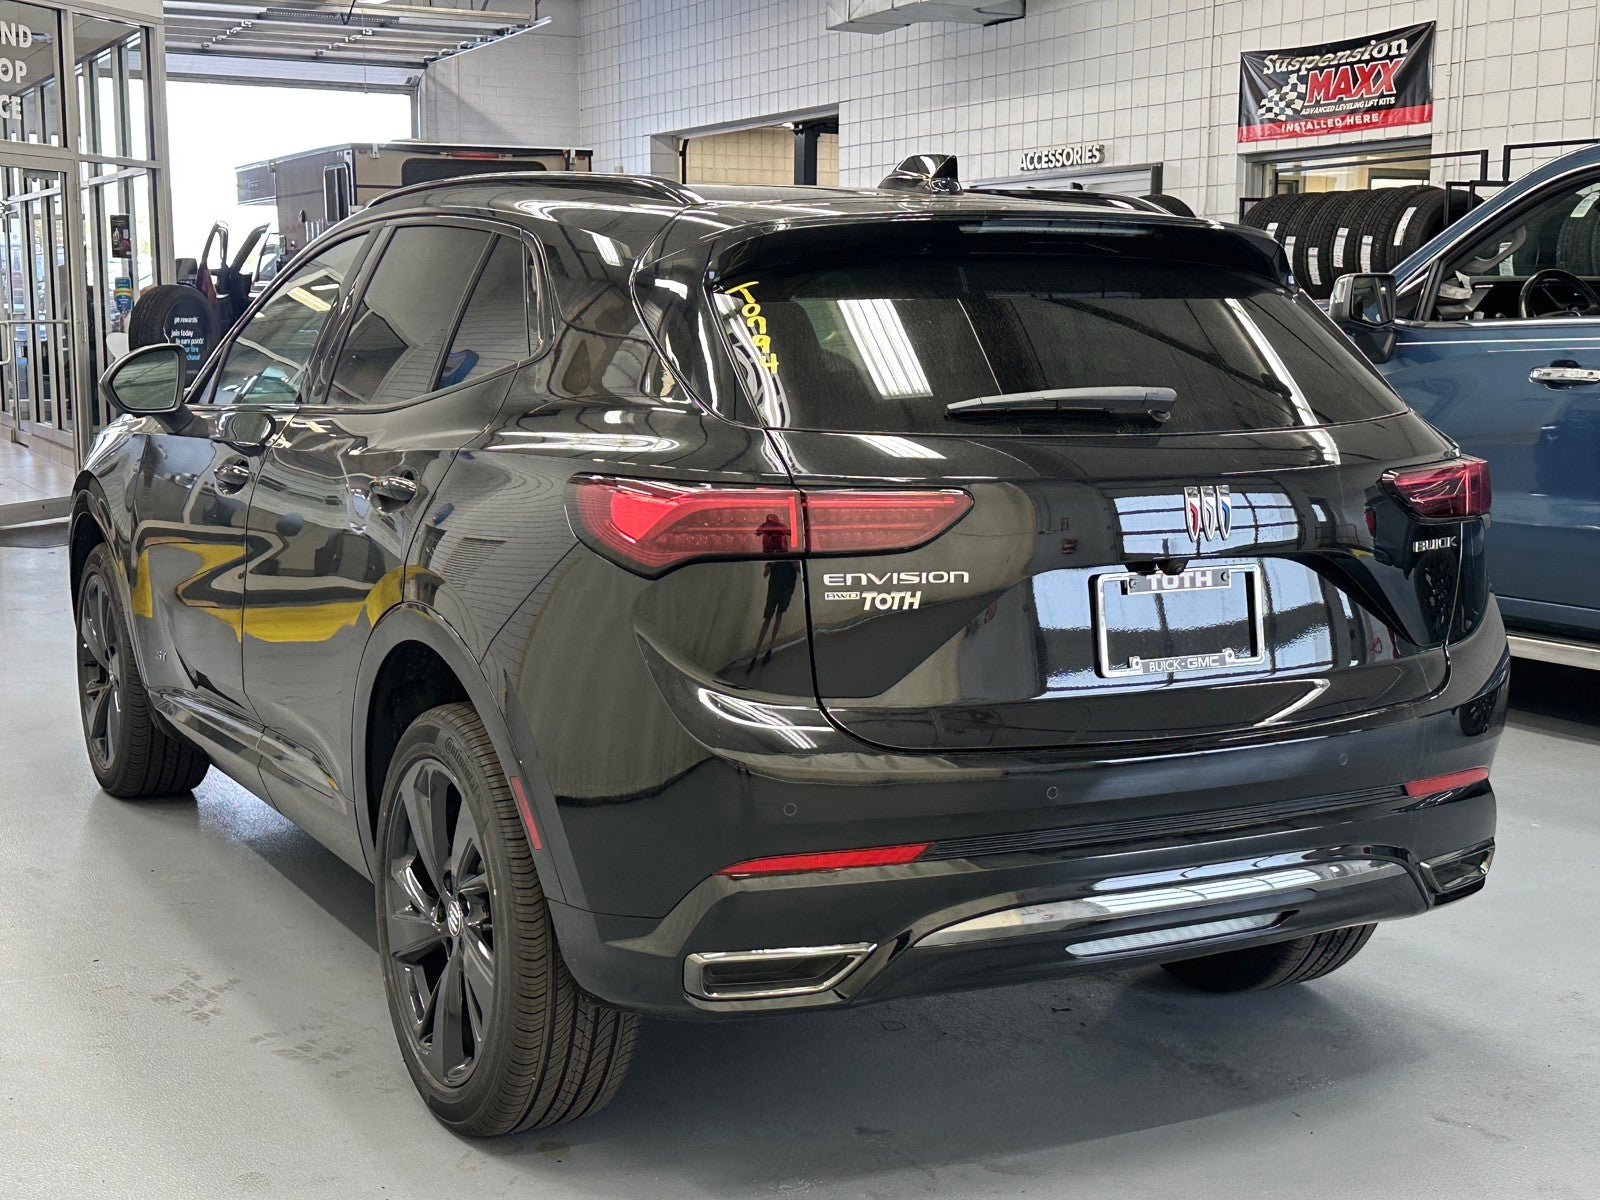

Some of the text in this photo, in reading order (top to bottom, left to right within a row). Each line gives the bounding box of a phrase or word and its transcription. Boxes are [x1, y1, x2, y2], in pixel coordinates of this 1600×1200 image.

[1263, 37, 1409, 75] Suspension
[1304, 57, 1407, 106] MAXX
[1300, 97, 1395, 115] ADVANCED LEVELING LIFT KITS
[1281, 113, 1379, 133] INSTALLED HERE
[1018, 144, 1103, 171] ACCESSORIES
[1413, 536, 1458, 553] BUICK
[823, 571, 970, 586] ENVISION
[1146, 570, 1213, 590] TOTH
[825, 591, 860, 601] AWD
[861, 591, 922, 611] TOTH
